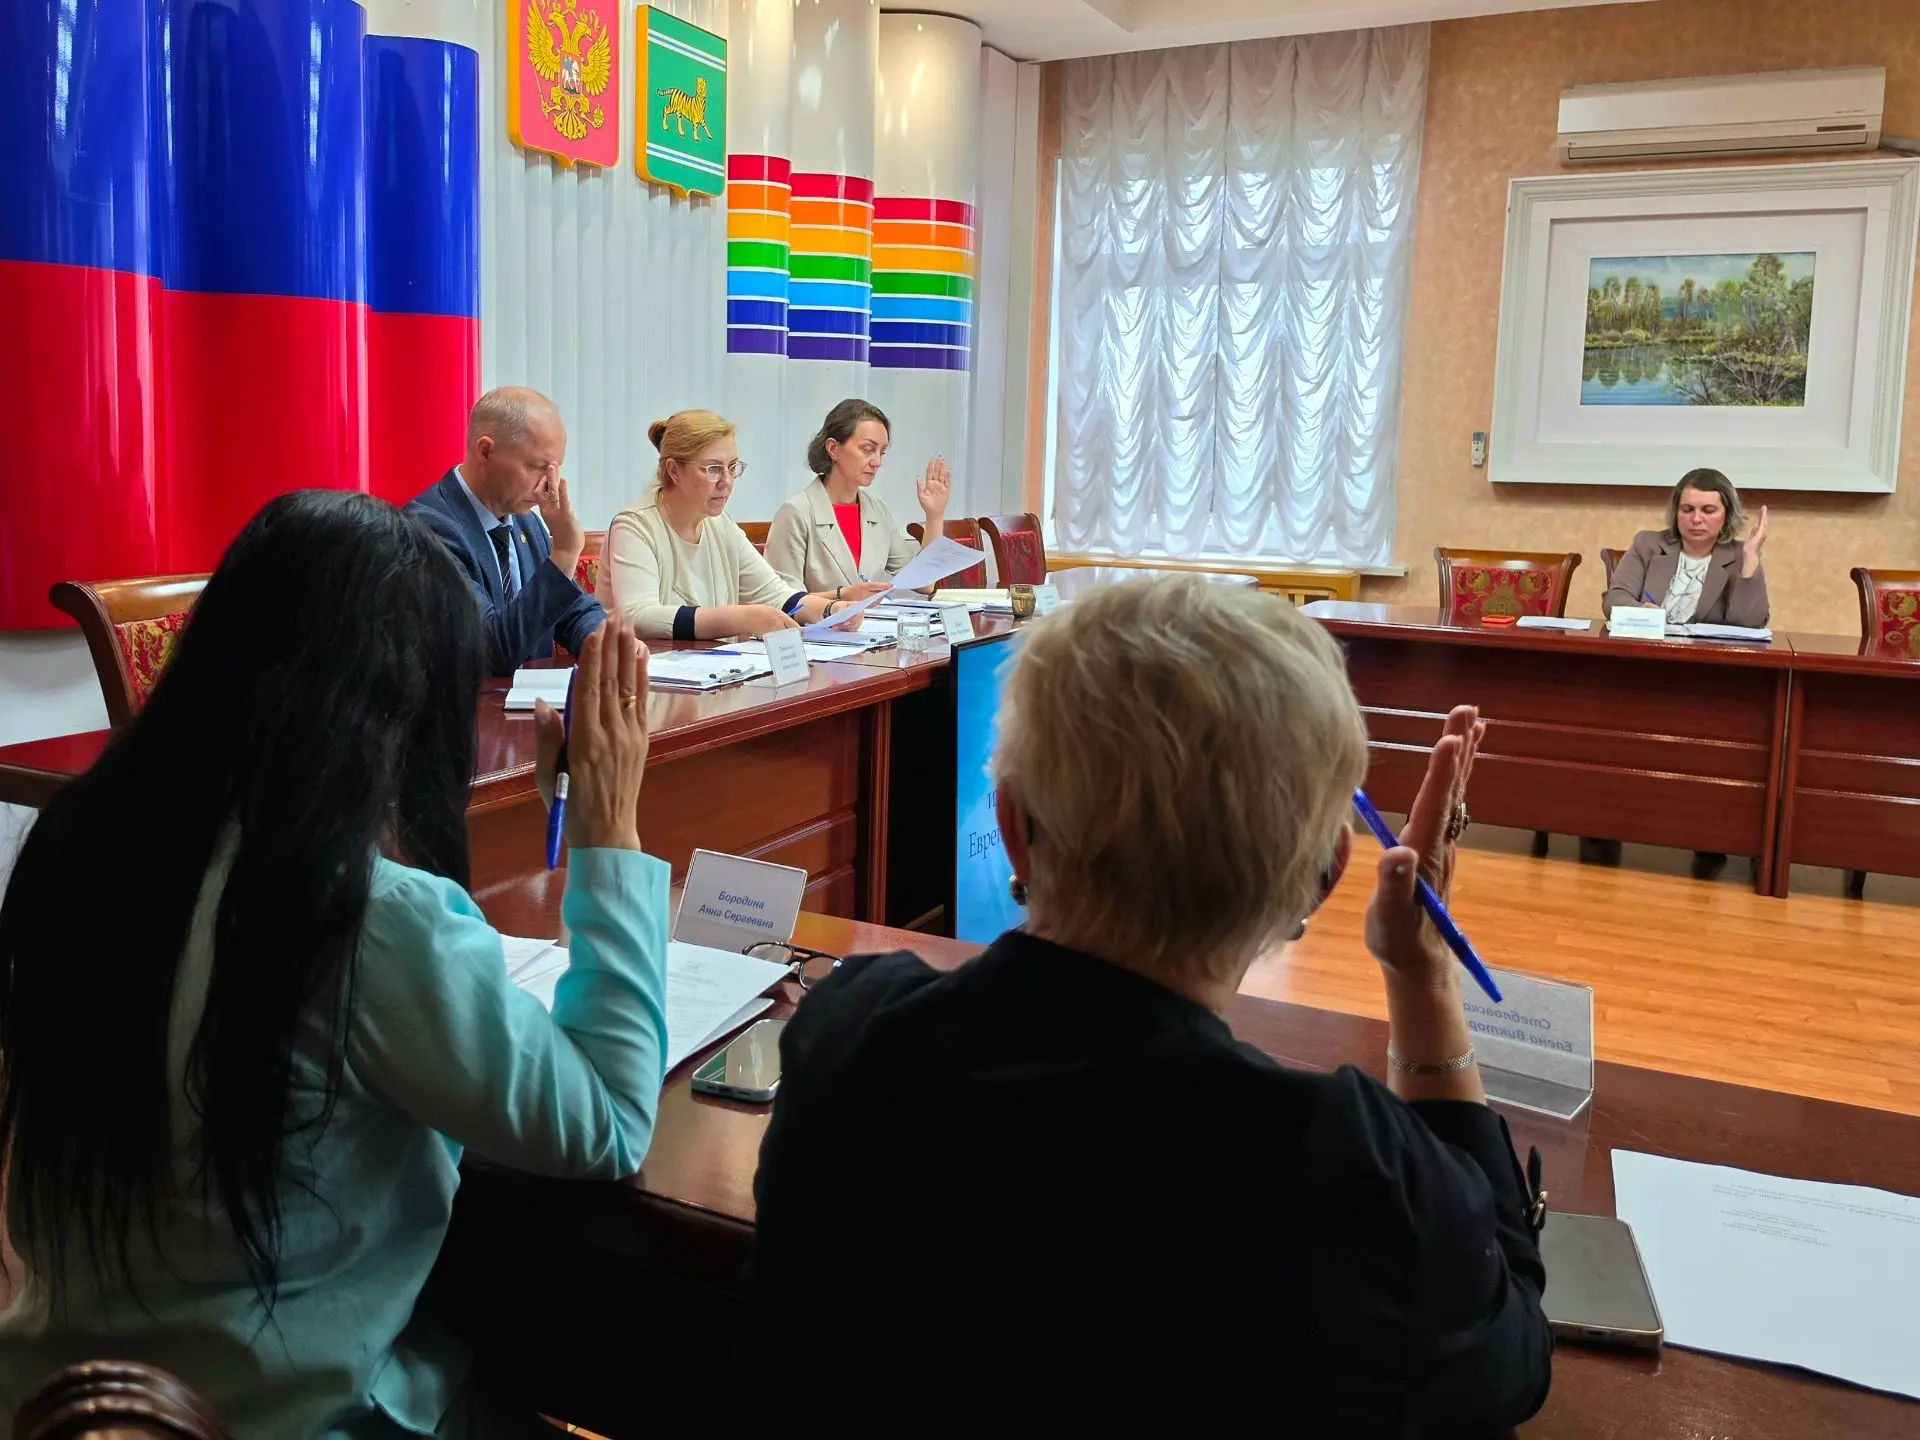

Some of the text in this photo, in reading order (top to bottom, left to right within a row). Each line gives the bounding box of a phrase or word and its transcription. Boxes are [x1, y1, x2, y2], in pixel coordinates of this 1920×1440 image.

[718, 891, 765, 910] Бородина
[698, 904, 774, 929] Анна Сергеевна
